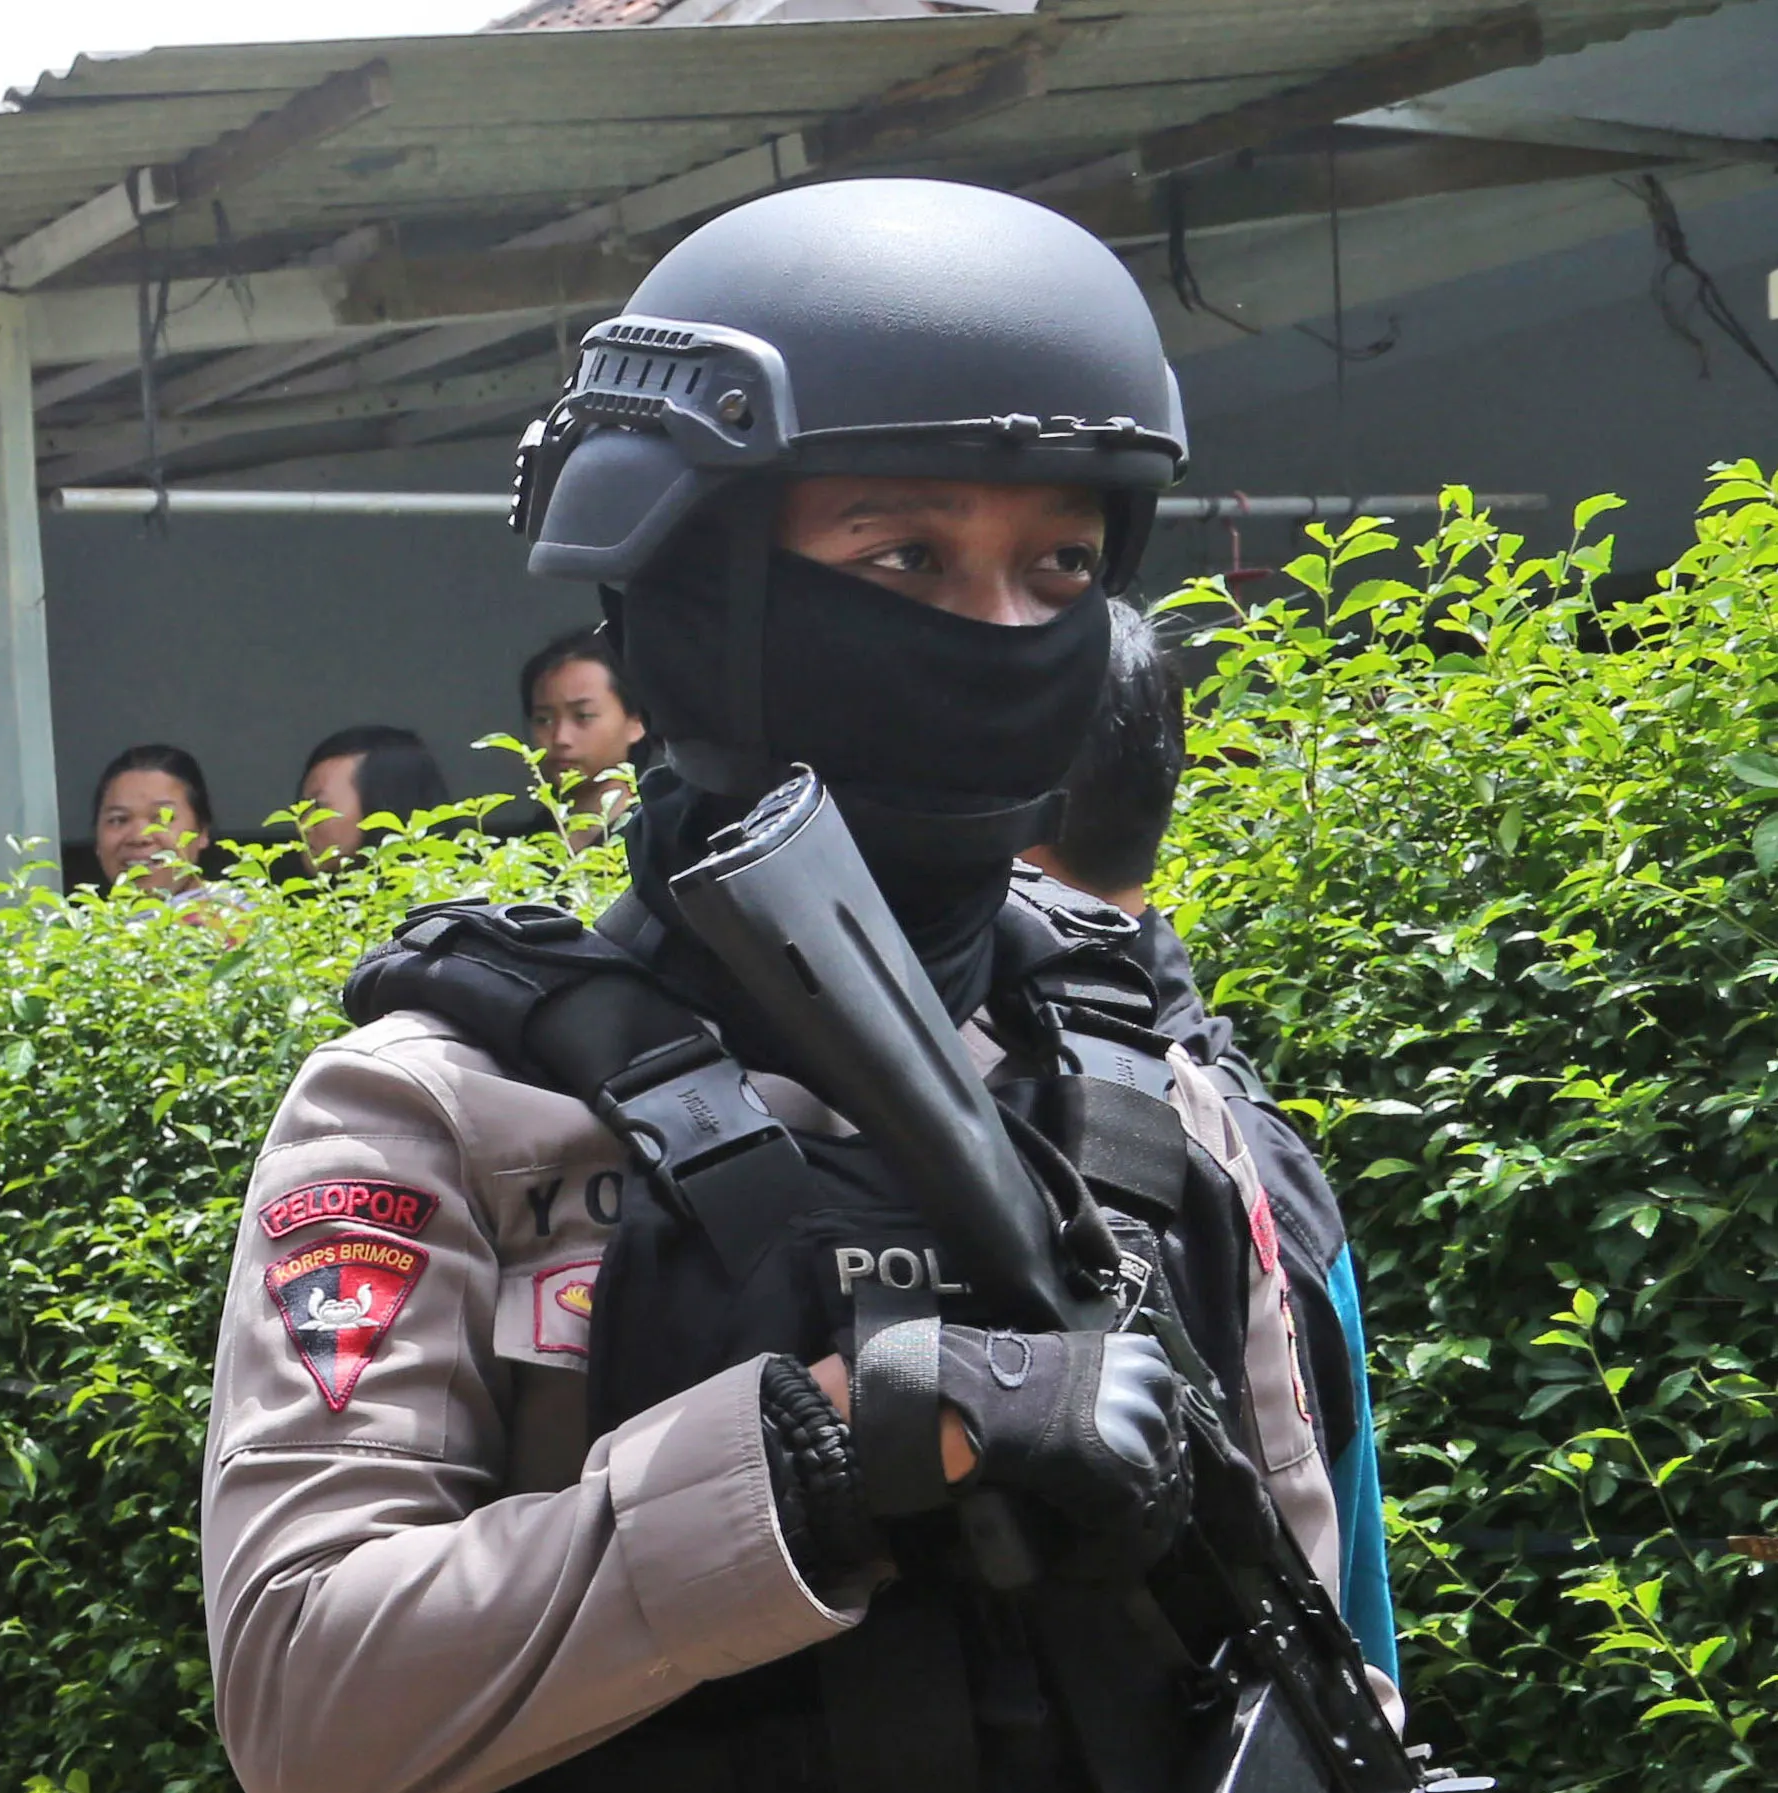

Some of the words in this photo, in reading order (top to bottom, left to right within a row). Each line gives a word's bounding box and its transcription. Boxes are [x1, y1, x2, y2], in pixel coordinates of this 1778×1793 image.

[270, 1185, 420, 1231] PELOPOR
[273, 1247, 336, 1283] KORPS
[339, 1243, 414, 1272] BRIMOB
[835, 1247, 972, 1295] POL
